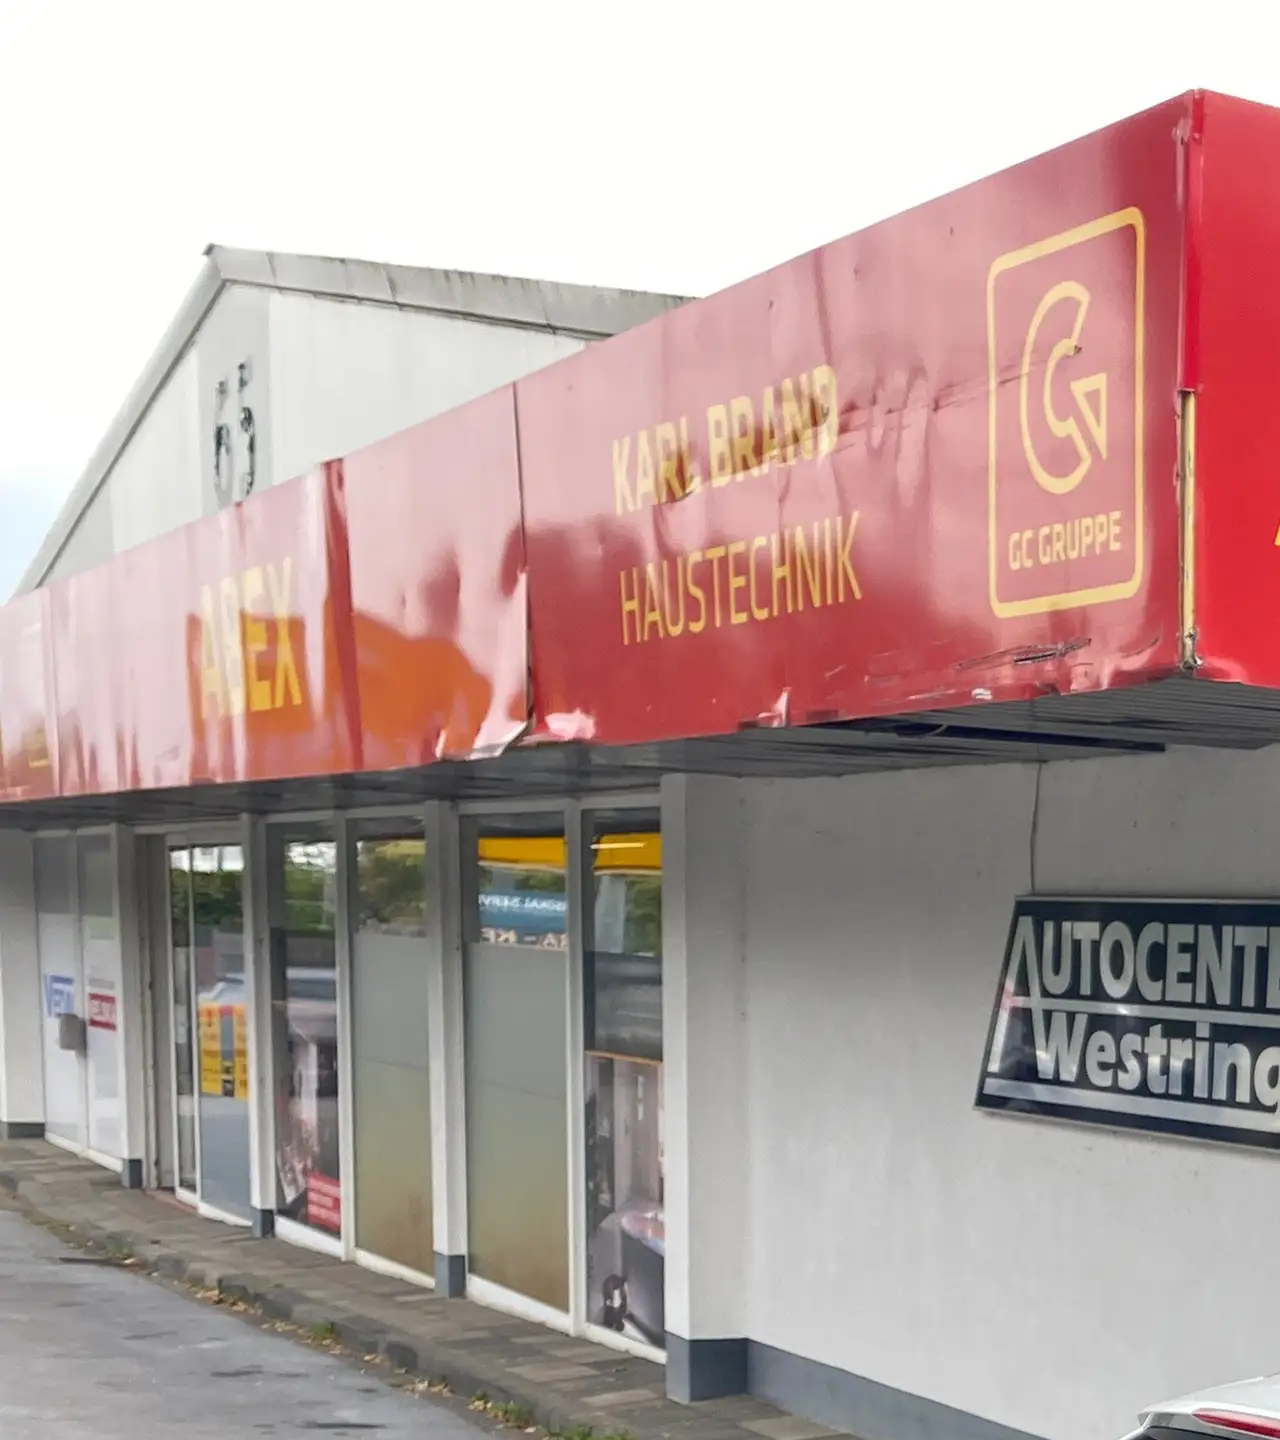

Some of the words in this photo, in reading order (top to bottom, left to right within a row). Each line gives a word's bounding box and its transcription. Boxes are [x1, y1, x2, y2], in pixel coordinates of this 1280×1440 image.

[612, 414, 702, 517] KARL
[706, 364, 838, 488] BRAND
[619, 510, 863, 646] HAUSTECHNIK
[1009, 530, 1034, 571] GC
[1038, 510, 1123, 567] GRUPPE
